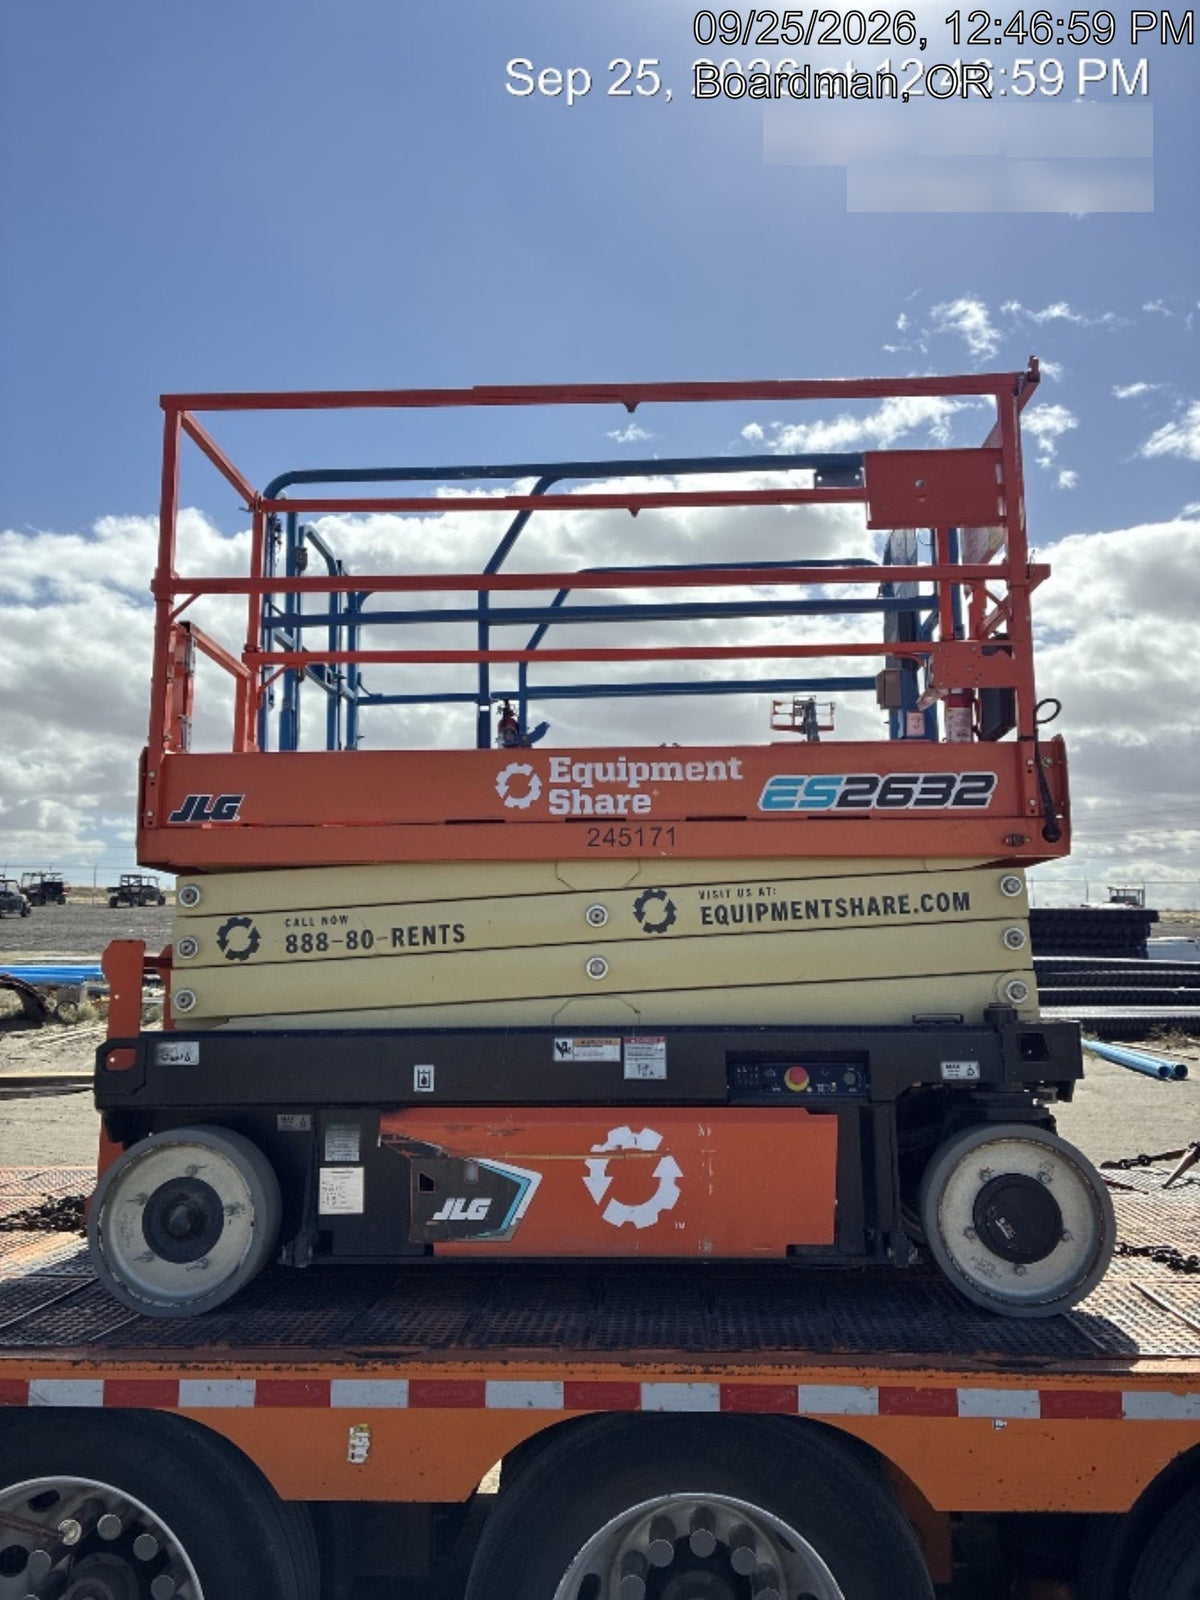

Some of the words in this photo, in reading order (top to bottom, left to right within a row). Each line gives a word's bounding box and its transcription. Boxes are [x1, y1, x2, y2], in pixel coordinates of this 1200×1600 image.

[549, 756, 743, 788] Equipment
[549, 789, 652, 815] Share
[757, 771, 998, 811] ES2632
[167, 794, 246, 823] JLG
[587, 826, 676, 848] 245171
[698, 889, 731, 900] VISIT
[737, 888, 752, 898] US
[758, 886, 777, 898] AT:
[285, 917, 315, 928] CALL
[321, 915, 349, 926] NOW
[701, 892, 970, 926] EQUIPMENTSHARE.COM
[285, 924, 466, 954] 888-80-RENTS
[432, 1198, 492, 1220] JLG
